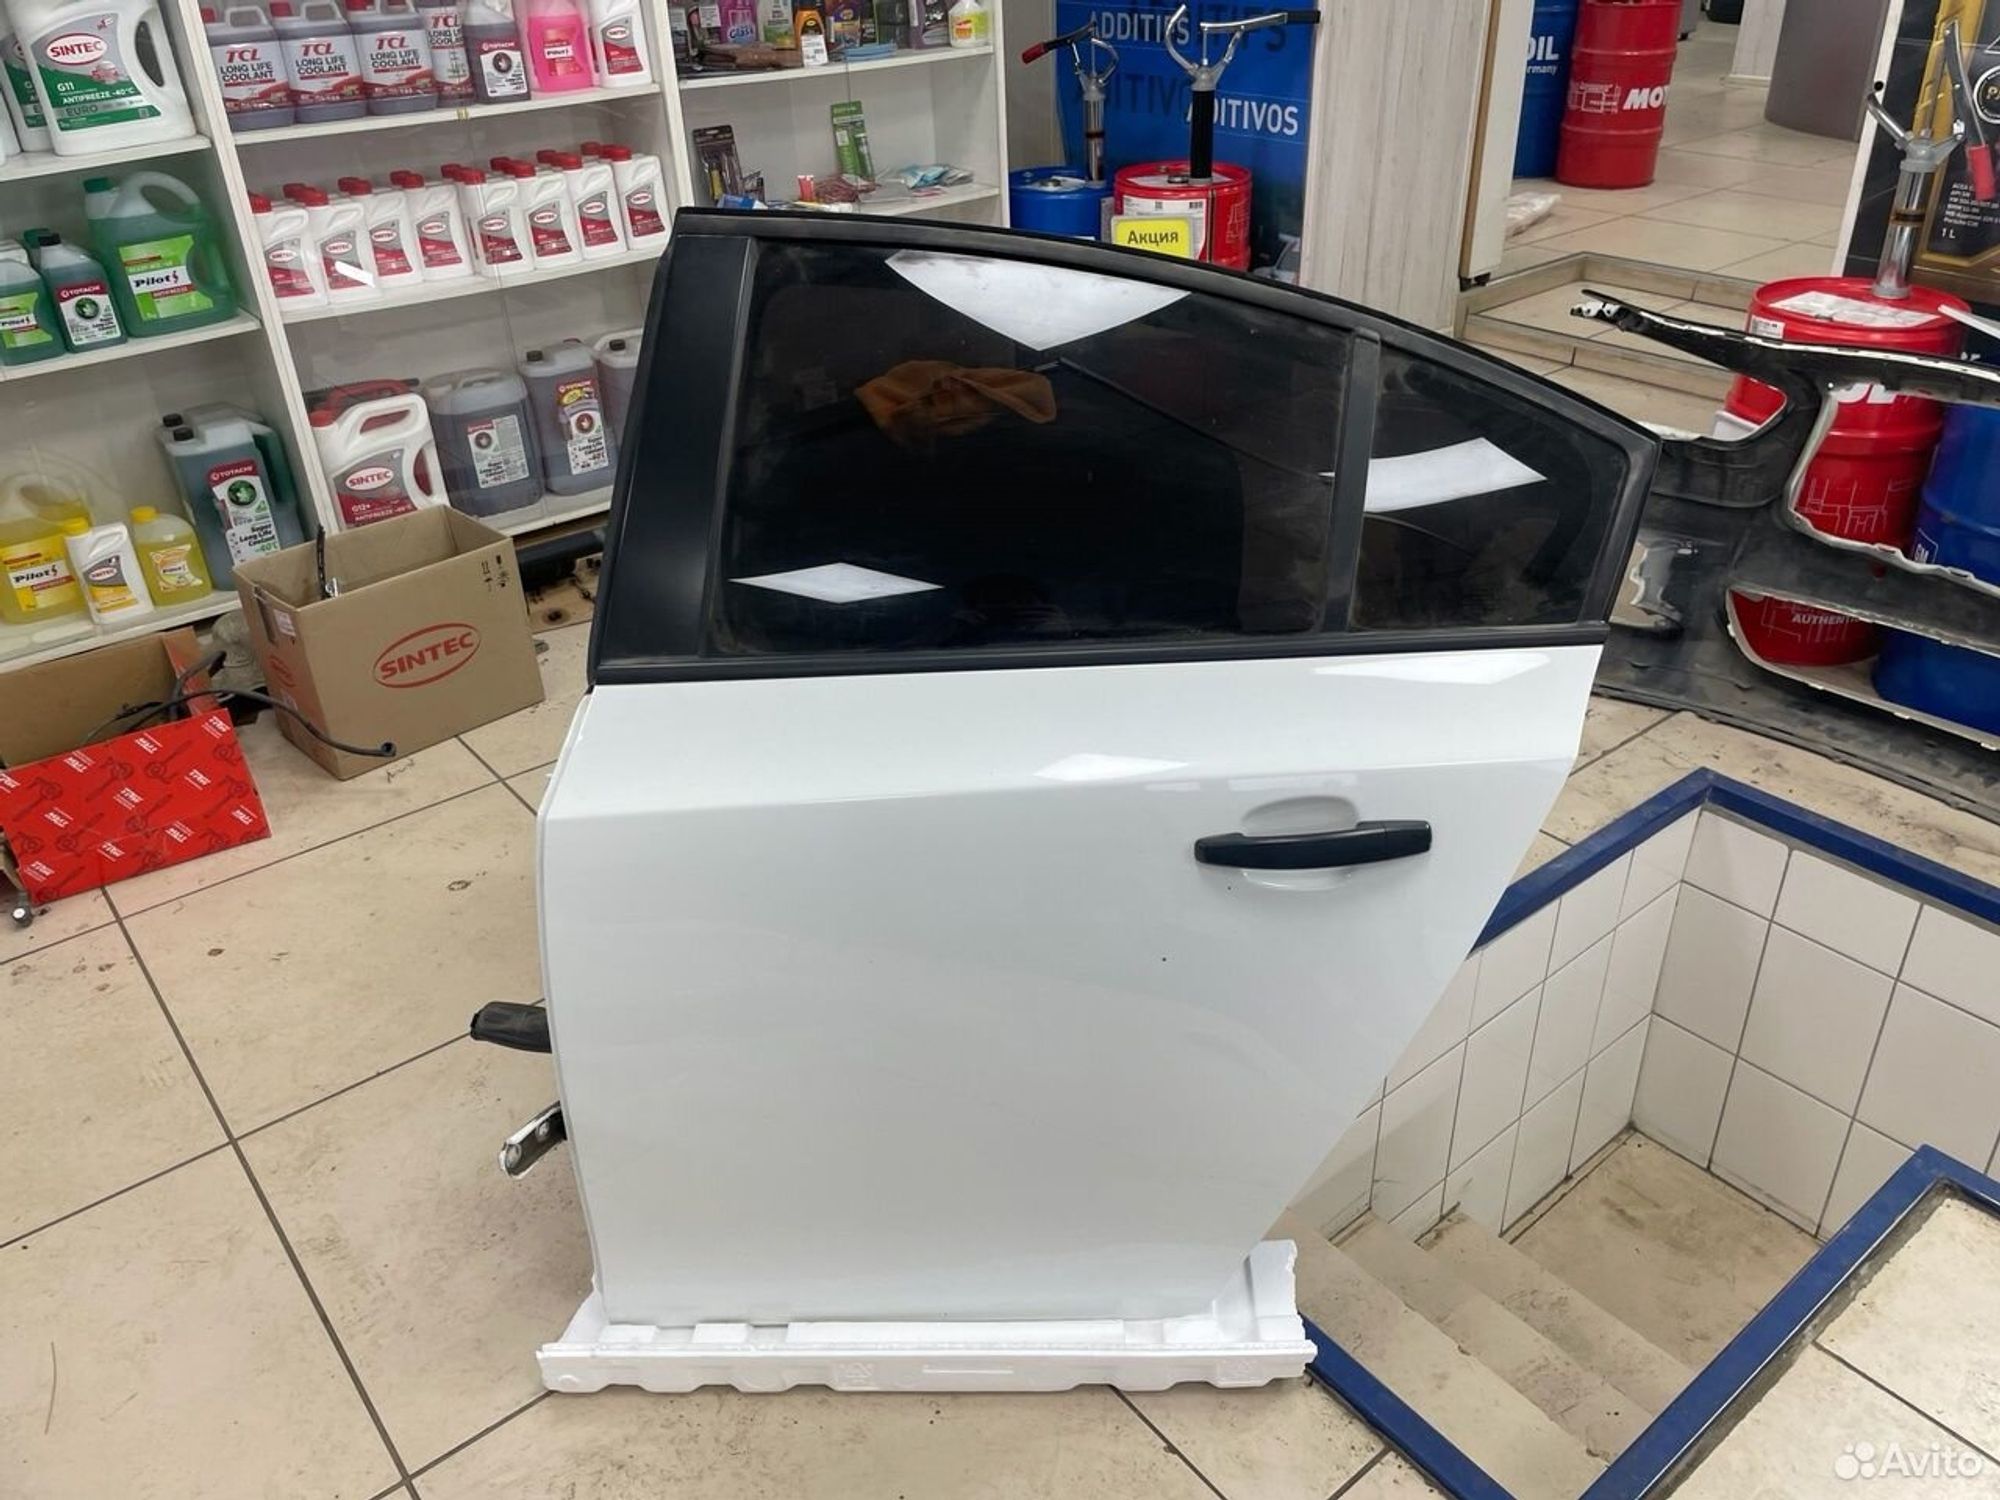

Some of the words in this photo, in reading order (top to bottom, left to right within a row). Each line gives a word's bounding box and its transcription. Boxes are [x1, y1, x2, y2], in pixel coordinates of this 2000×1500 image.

[50, 40, 103, 58] SINTEC
[302, 42, 336, 56] TCL
[376, 36, 409, 50] TCL
[226, 48, 261, 63] TCL
[295, 57, 322, 67] LONG
[325, 54, 346, 65] LIFE
[370, 51, 397, 61] LONG
[400, 49, 421, 59] LIFE
[220, 64, 249, 75] LONG
[251, 60, 273, 71] LIFE
[297, 64, 347, 75] COOLANT
[372, 57, 422, 69] COOLANT
[222, 70, 274, 82] COOLANT
[57, 81, 75, 92] G11
[62, 90, 111, 104] ANTIFREEZE
[66, 104, 98, 116] EURO
[1186, 96, 1299, 136] ITIVOS
[1127, 230, 1179, 246] Акция
[1942, 227, 1947, 238] 1
[1949, 229, 1956, 239] L
[220, 465, 253, 477] TOTACHI
[348, 470, 392, 487] SINTEC
[251, 523, 272, 533] Super
[239, 533, 258, 543] Long
[248, 535, 276, 547] Coolant
[380, 631, 475, 681] SINTEC
[208, 715, 231, 733] TRW
[189, 768, 212, 786] TRW
[120, 787, 144, 804] TRW
[102, 841, 126, 858] TRW
[30, 860, 56, 877] TRW
